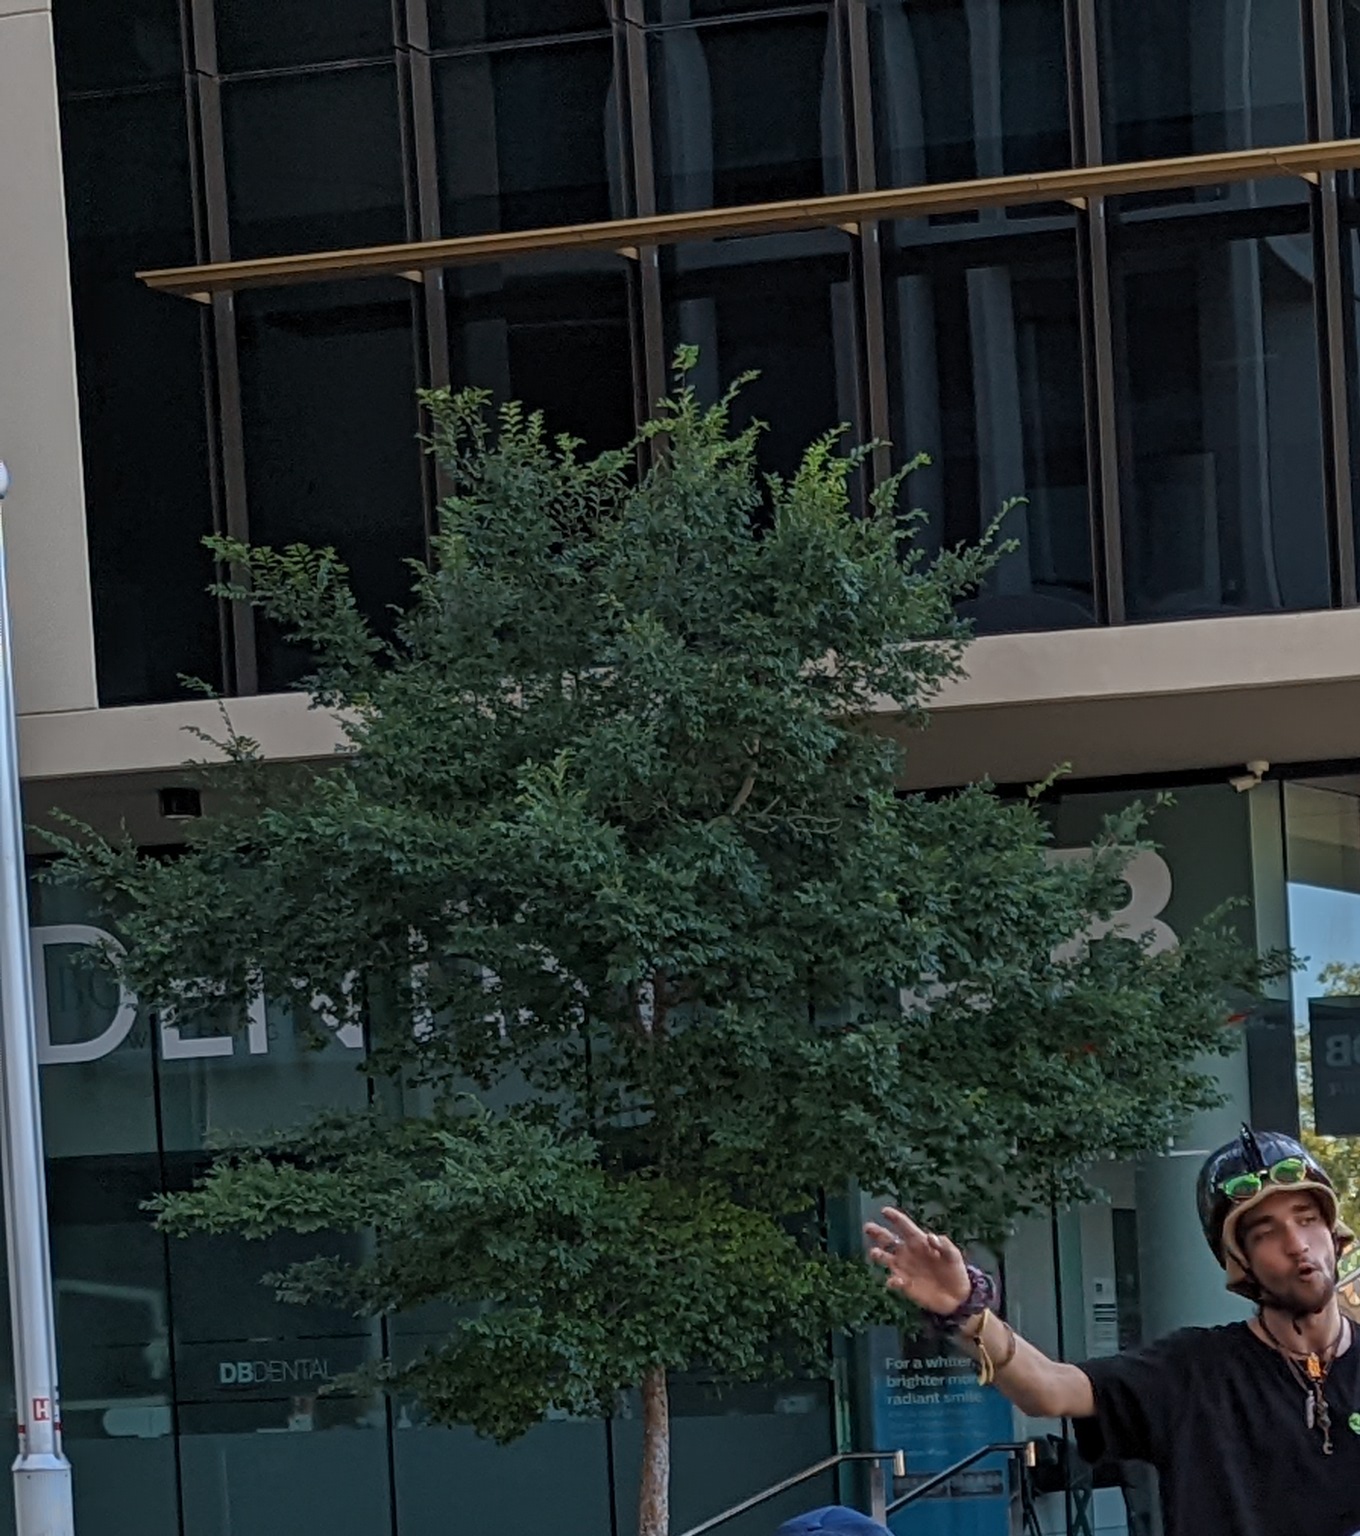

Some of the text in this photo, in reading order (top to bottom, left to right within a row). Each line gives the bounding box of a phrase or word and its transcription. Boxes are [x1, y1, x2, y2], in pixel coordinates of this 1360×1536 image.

[885, 1357, 910, 1370] For
[912, 1359, 923, 1369] a
[886, 1374, 945, 1390] brighter
[887, 1392, 940, 1405] radiant
